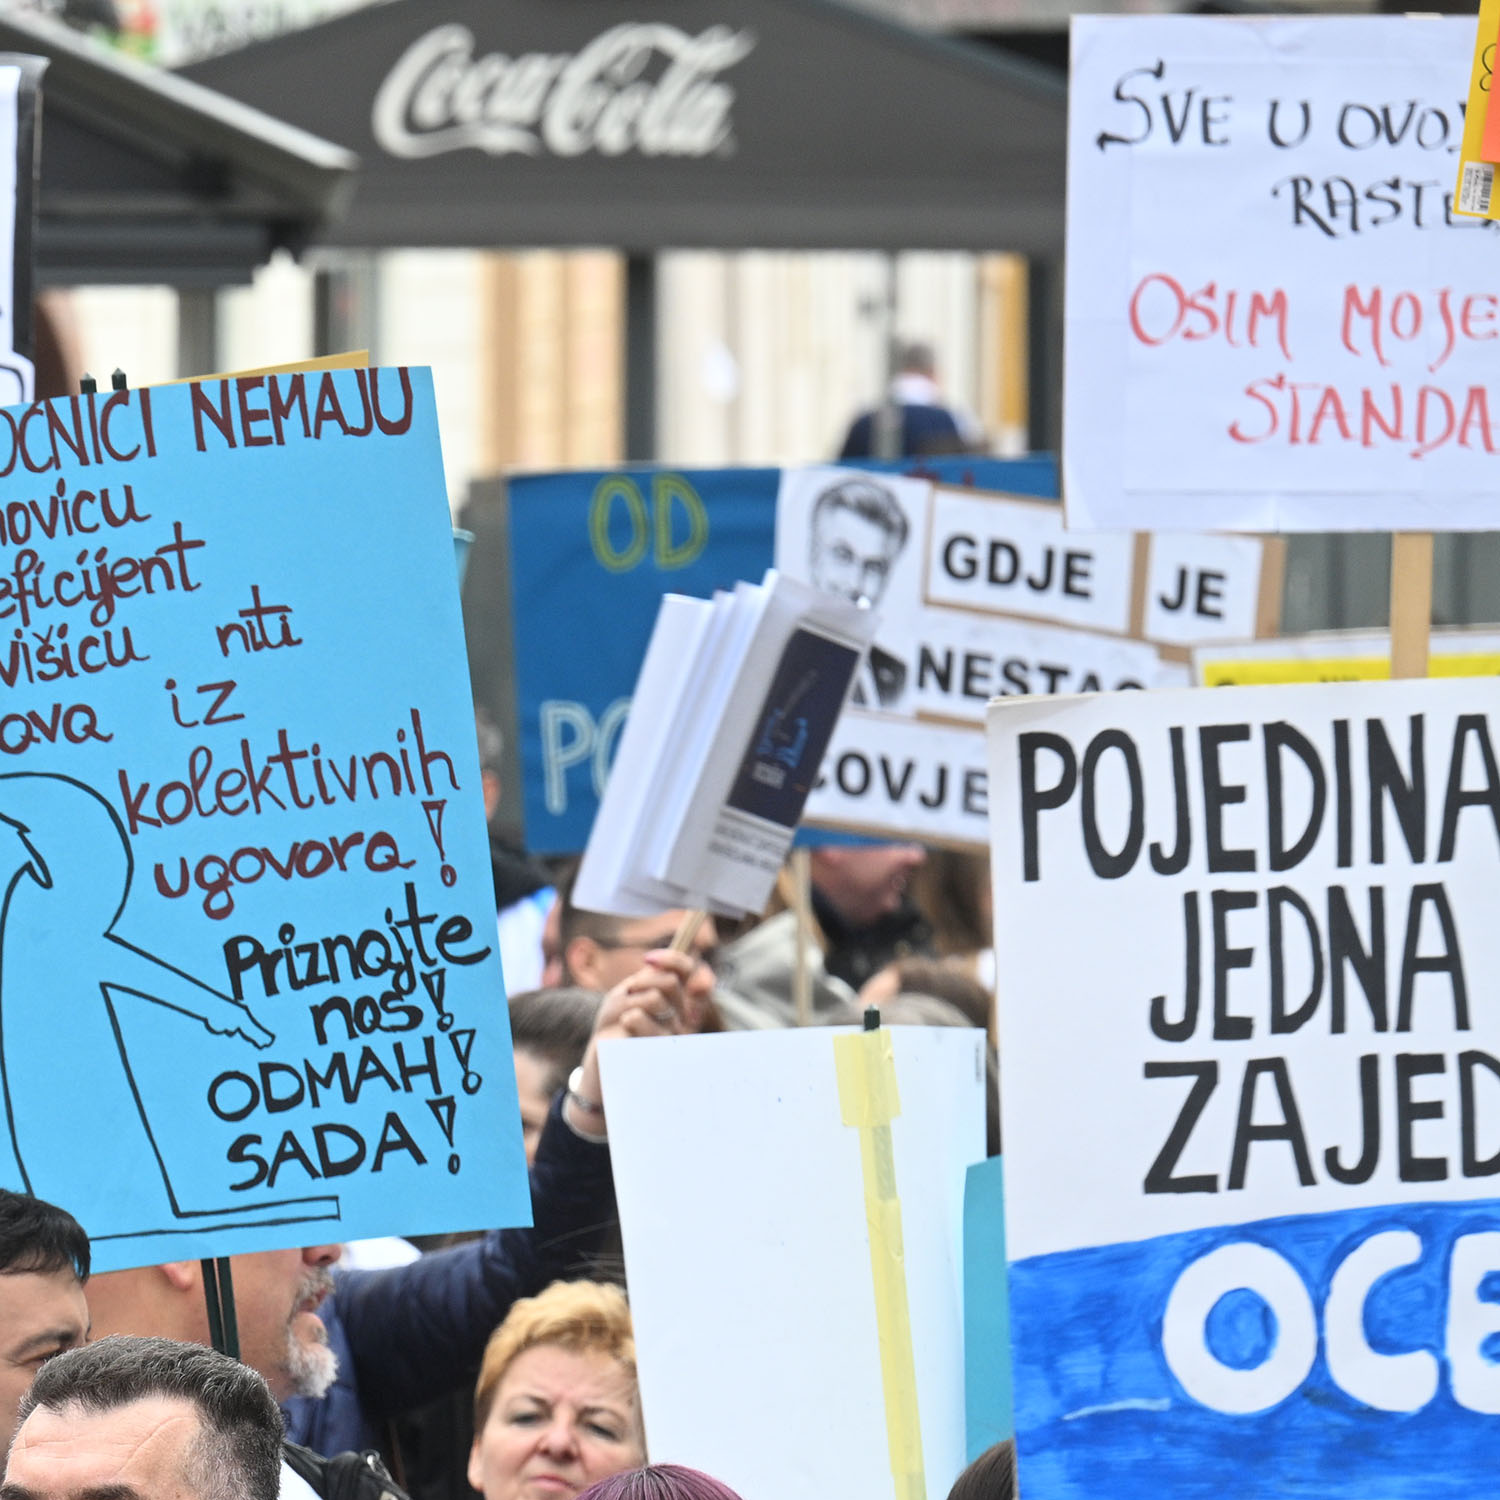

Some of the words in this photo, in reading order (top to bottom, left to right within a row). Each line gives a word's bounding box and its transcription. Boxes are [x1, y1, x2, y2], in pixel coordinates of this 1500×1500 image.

[370, 20, 750, 160] Coca-Cola
[1096, 60, 1231, 150] SVE
[1267, 100, 1312, 148] U
[1336, 102, 1466, 154] OVO
[1129, 272, 1292, 362] OSIM
[188, 366, 416, 452] NEMAJU
[589, 474, 708, 574] OD
[942, 534, 1094, 602] GDJE
[1158, 566, 1228, 622] JE
[163, 676, 246, 730] iz
[116, 707, 462, 836] kolektivnih
[812, 750, 990, 826] OVJE
[222, 882, 494, 1002] Priznajte
[1150, 882, 1471, 1043] JEDNA
